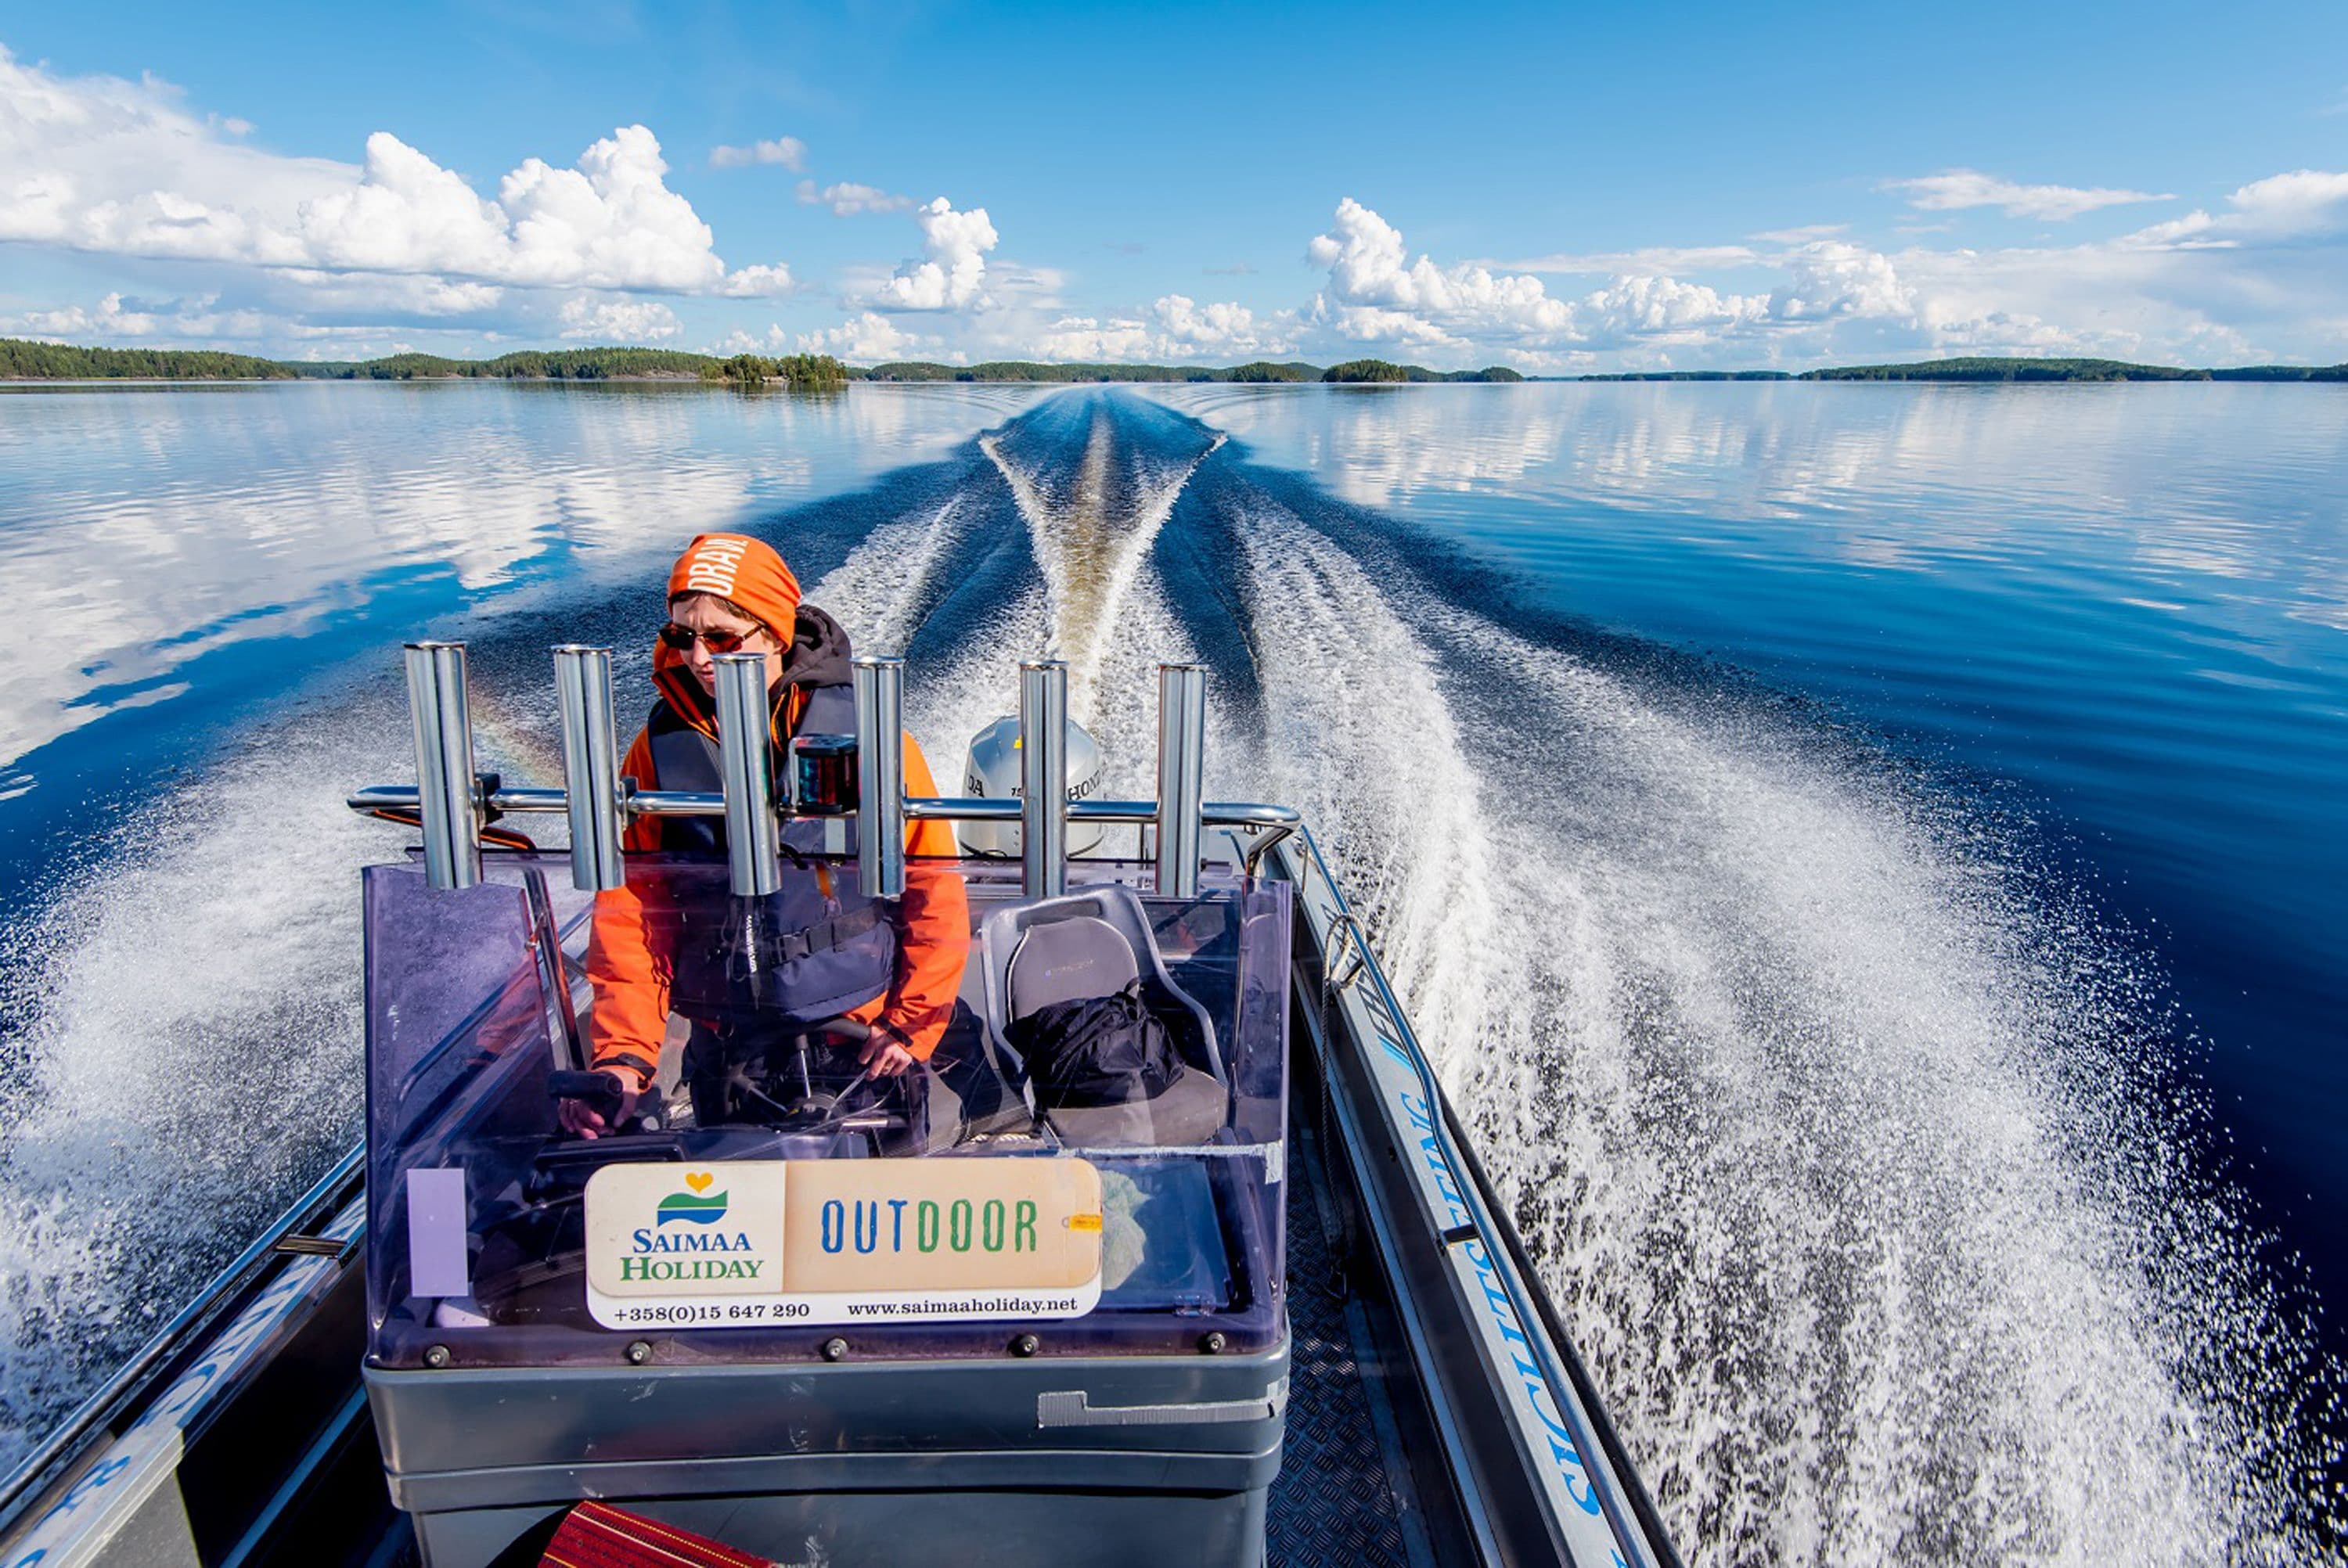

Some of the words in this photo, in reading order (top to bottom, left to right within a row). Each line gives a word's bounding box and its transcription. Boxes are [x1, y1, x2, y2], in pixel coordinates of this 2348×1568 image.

[820, 1199, 1037, 1253] OUTDOOR
[633, 1228, 753, 1253] SAIMAA
[620, 1257, 765, 1281] HOLIDAY
[614, 1305, 721, 1323] +358(0)15
[729, 1304, 765, 1319] 647
[772, 1303, 810, 1318] 290
[847, 1297, 1078, 1315] www.saimaaholiday.net
